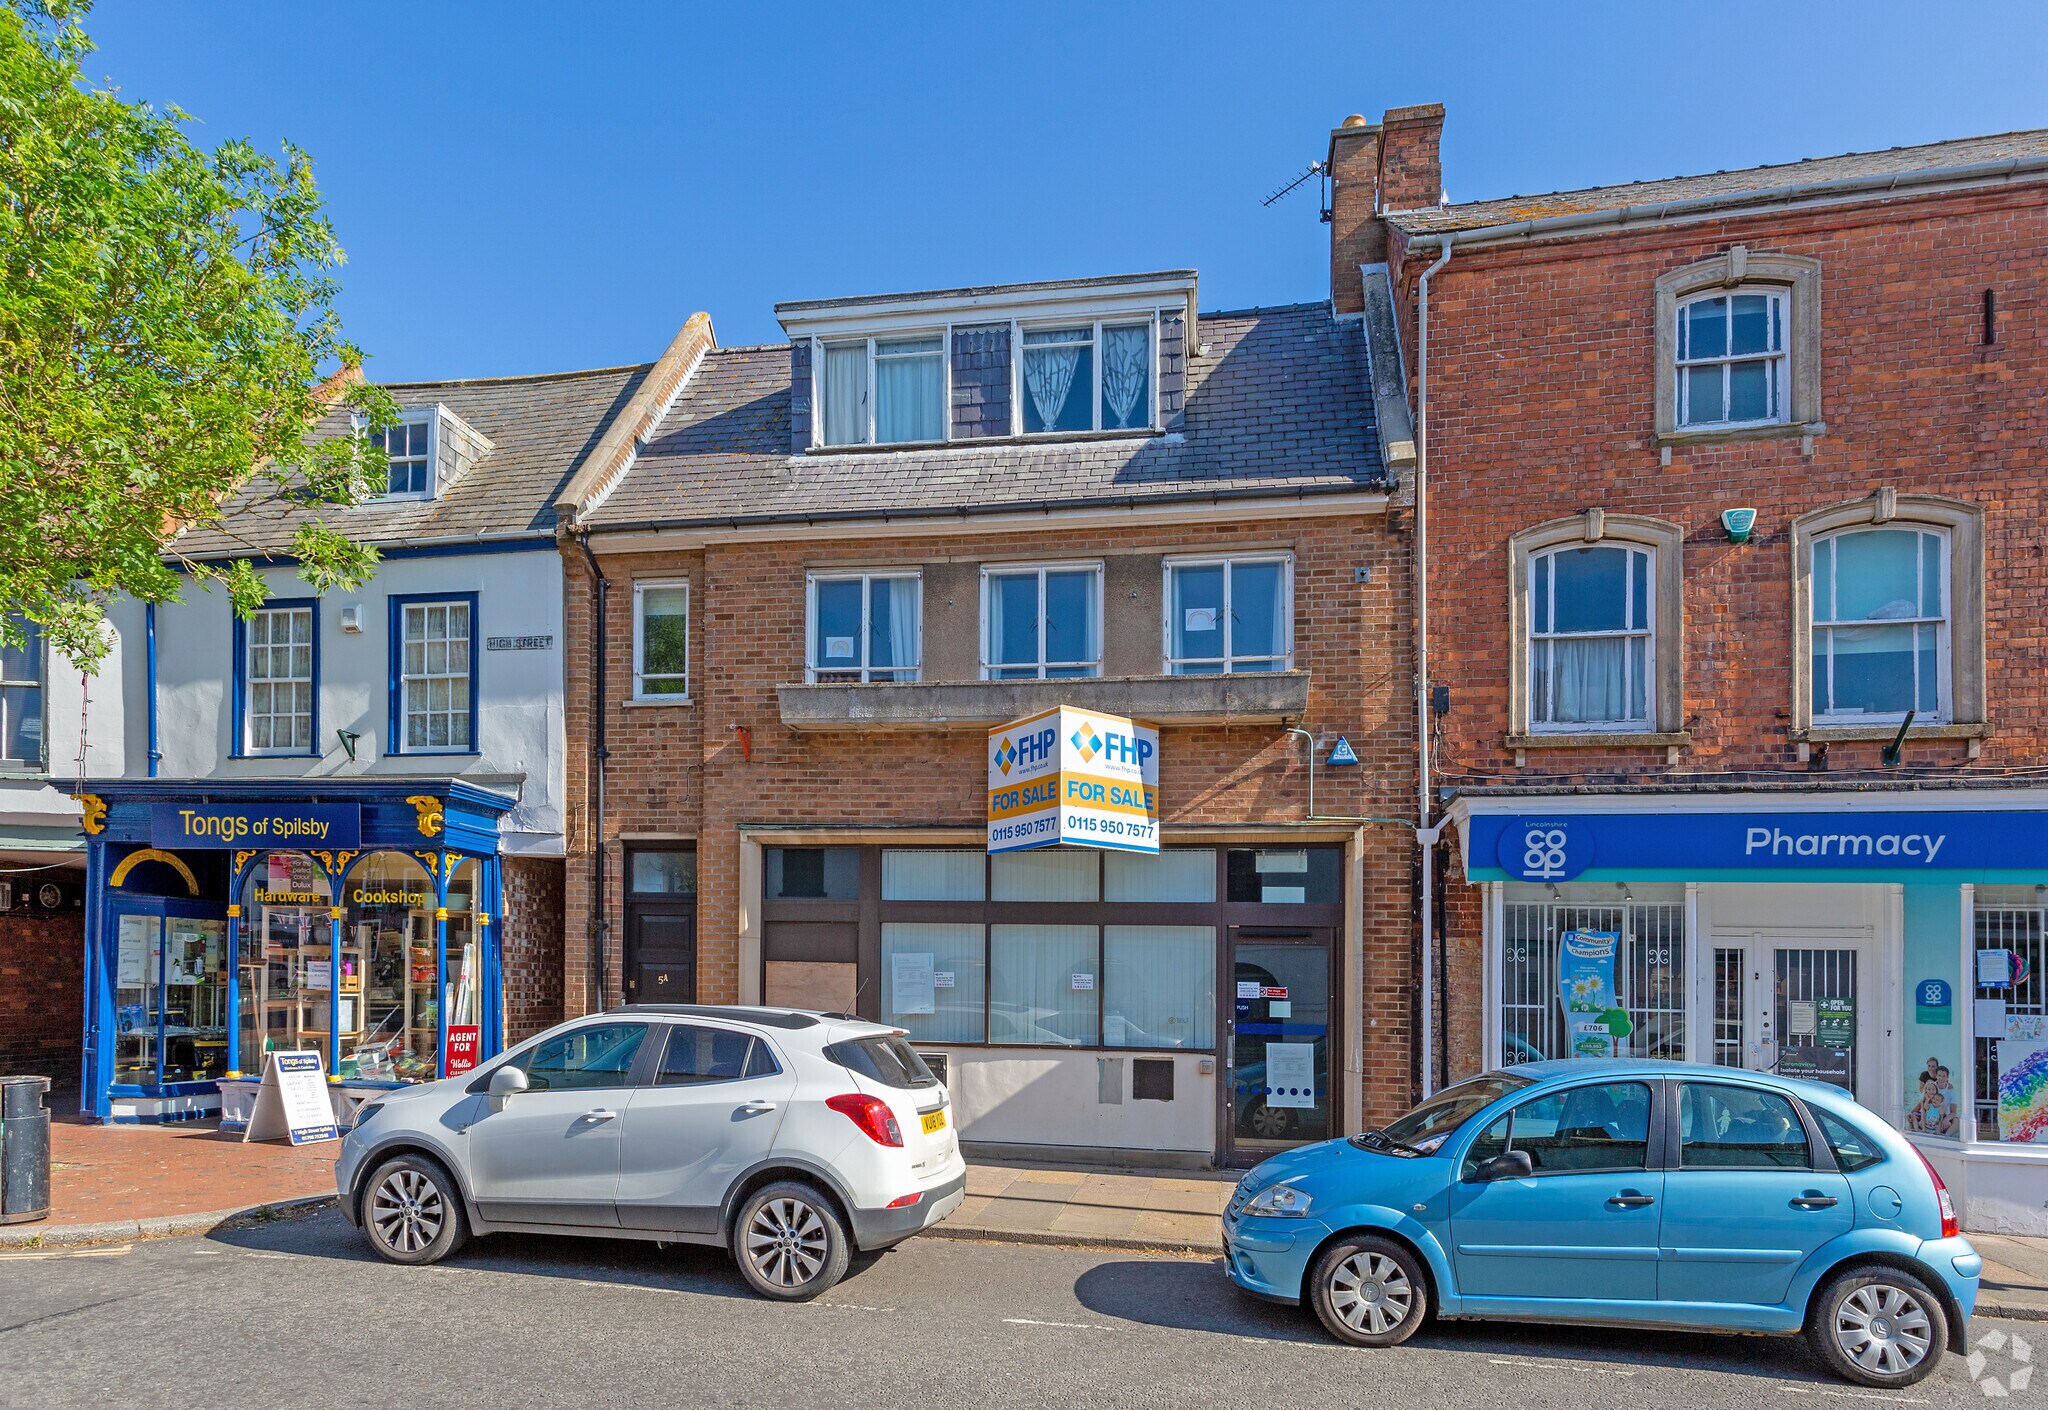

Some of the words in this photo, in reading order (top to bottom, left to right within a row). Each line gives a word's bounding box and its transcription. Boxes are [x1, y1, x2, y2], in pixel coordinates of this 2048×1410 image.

[489, 639, 512, 649] HIGH
[515, 637, 552, 648] STREET
[1019, 728, 1056, 766] FHP
[1105, 732, 1153, 767] FHP
[1018, 761, 1049, 775] www.fhp.co.uk
[1105, 764, 1144, 776] www.fhp.co.uk
[992, 790, 1019, 812] FOR
[1022, 780, 1057, 805] SALE
[1067, 780, 1105, 803] FOR
[1110, 786, 1154, 811] SALE
[179, 810, 248, 842] Tongs
[253, 817, 268, 835] of
[272, 817, 330, 840] Spilsby
[992, 823, 1013, 842] 0115
[1014, 820, 1033, 837] 950
[1034, 816, 1057, 834] 7577
[1068, 815, 1097, 832] 0115
[1100, 819, 1124, 835] 950
[1126, 822, 1154, 839] 7577
[1745, 827, 1946, 863] Pharmacy
[292, 881, 312, 889] Dulux
[254, 888, 321, 903] Hardware
[353, 889, 426, 906] Cookshop
[1575, 934, 1611, 945] Community
[1571, 947, 1610, 957] Champions
[658, 973, 669, 985] 5A
[449, 1032, 477, 1042] AGENT
[453, 1042, 471, 1052] FOR
[280, 1057, 299, 1067] Tongs
